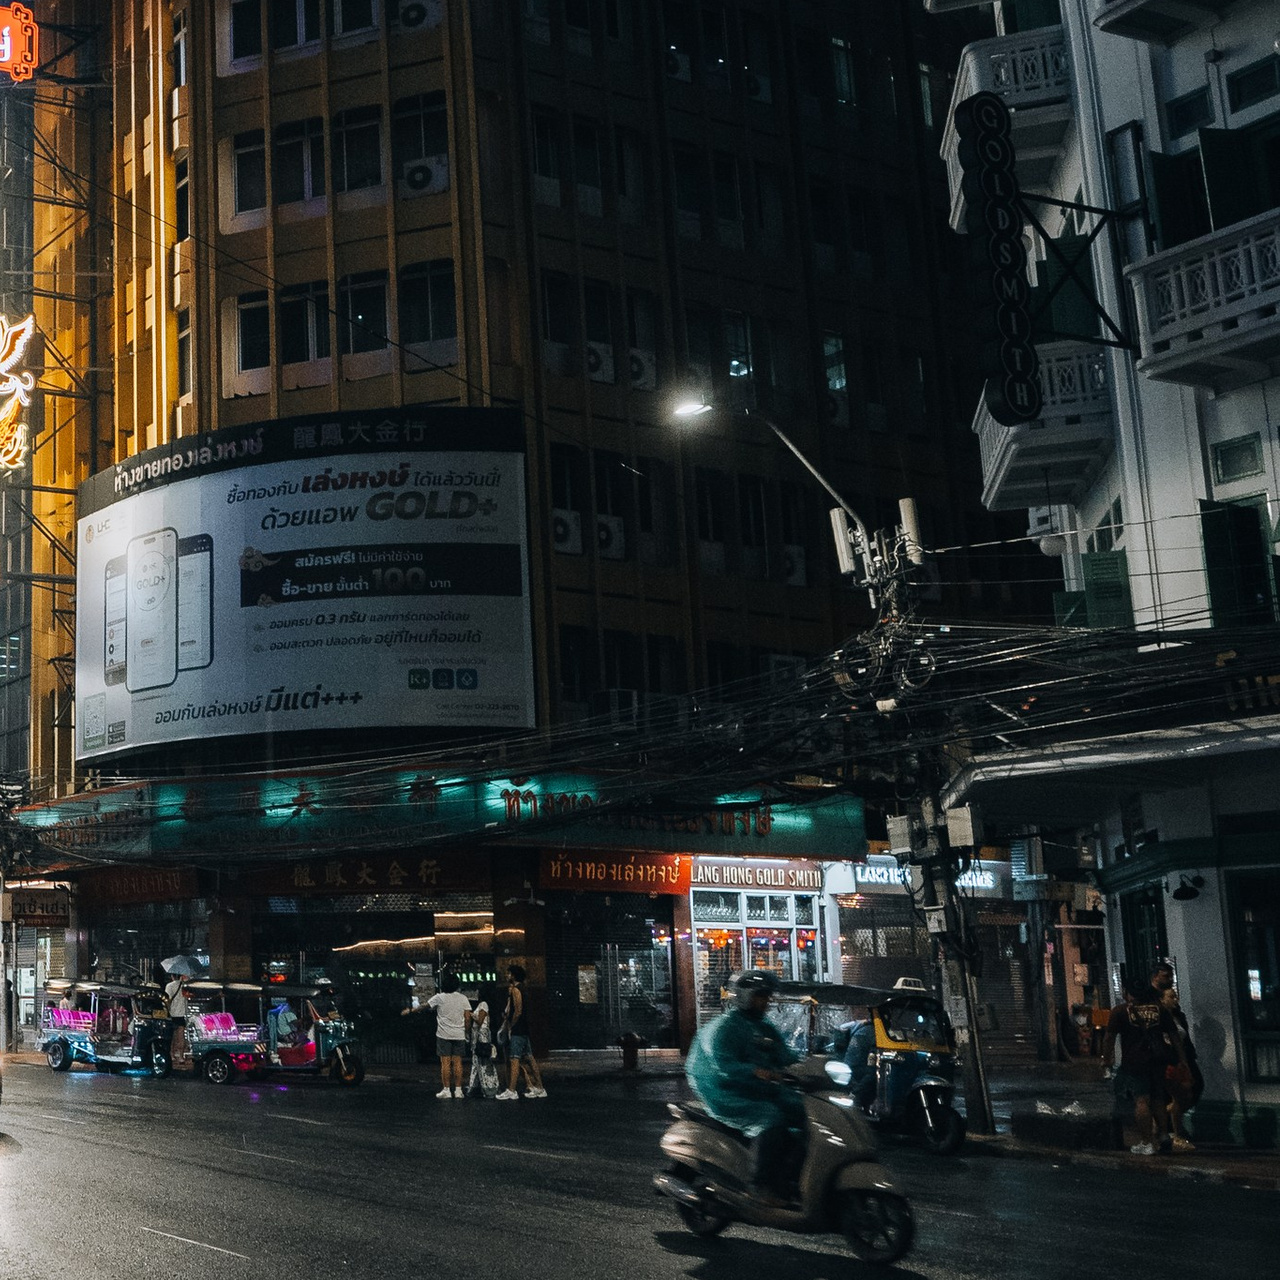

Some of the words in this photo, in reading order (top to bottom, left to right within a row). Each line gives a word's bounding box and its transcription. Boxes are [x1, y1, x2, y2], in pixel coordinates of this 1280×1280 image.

[981, 105, 1029, 408] GOLDSMITH
[293, 419, 427, 450] 龍鳳大金行
[301, 462, 410, 494] เล่งหงษ์
[261, 504, 359, 531] ด้วยแอพ
[365, 490, 498, 521] GOLD+
[371, 567, 427, 592] 100
[429, 578, 452, 590] บาท
[315, 613, 337, 626] 0.3
[338, 611, 367, 624] กรัม
[155, 695, 262, 725] ออมกับเล่งหงษ์
[550, 853, 680, 885] ห้างทองเล่งหงษ์
[690, 865, 719, 884] LANG
[722, 866, 753, 885] HONG
[756, 868, 784, 886] GOLD
[788, 870, 822, 888] SMITH
